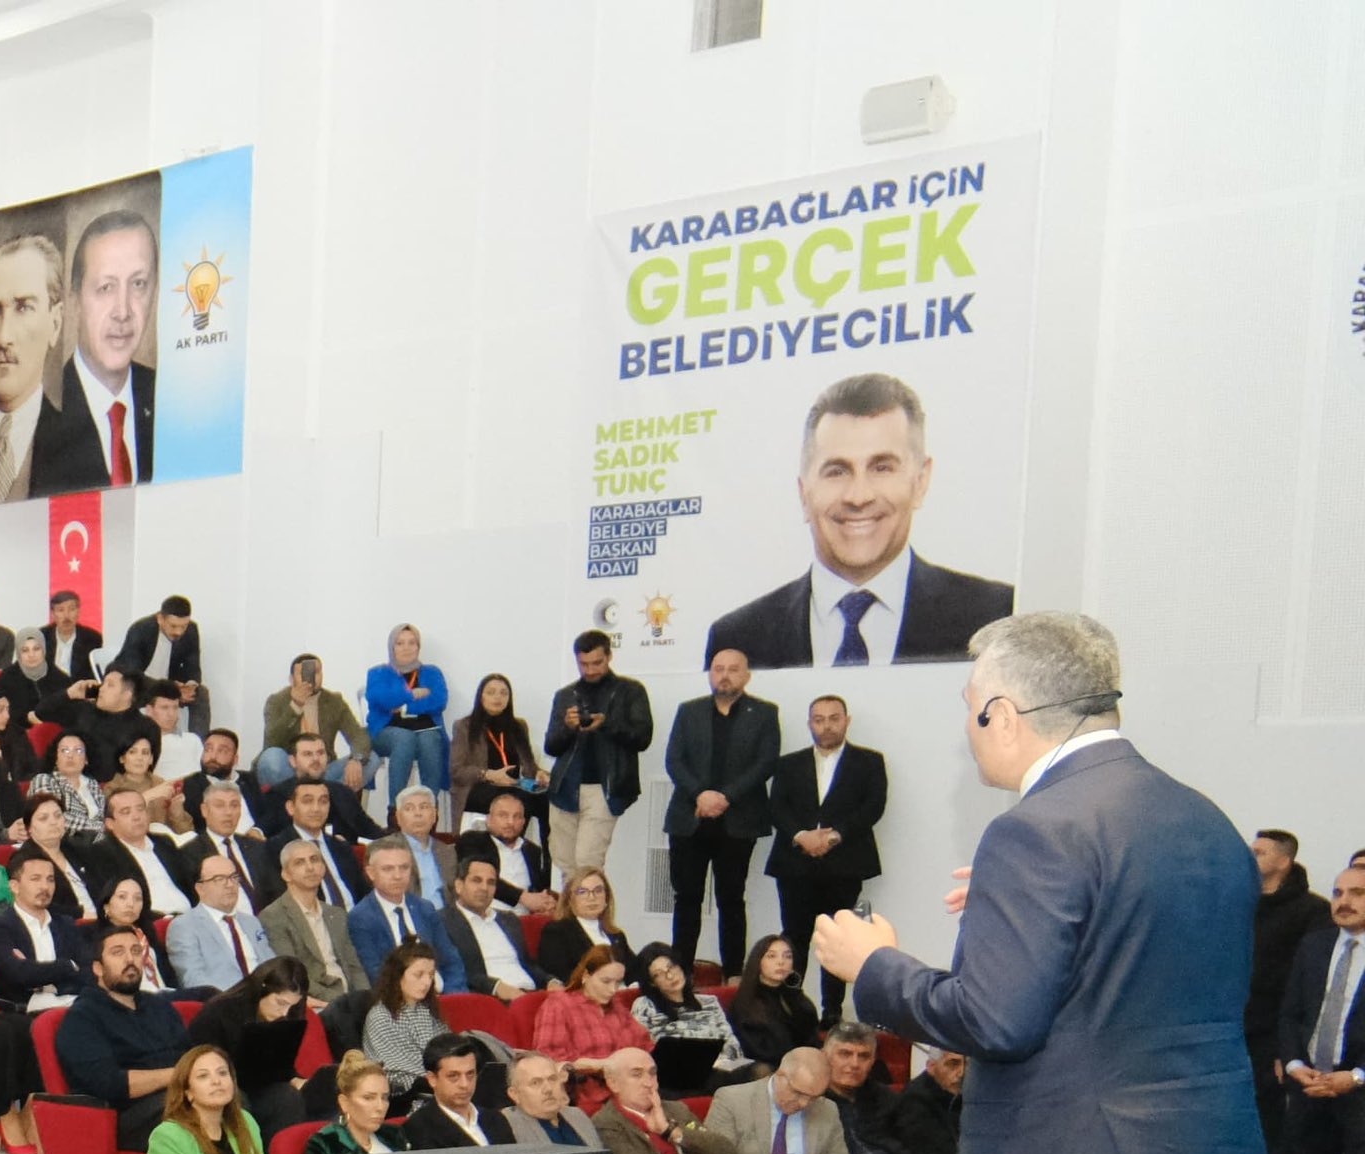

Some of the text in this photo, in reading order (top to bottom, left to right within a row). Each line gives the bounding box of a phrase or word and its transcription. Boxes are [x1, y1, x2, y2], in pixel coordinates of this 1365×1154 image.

[630, 183, 898, 253] KARABAĞLAR
[626, 203, 982, 326] GERÇEK
[176, 337, 191, 351] AK
[595, 409, 719, 445] MEHMET
[593, 440, 681, 471] SADIK
[592, 467, 667, 497] TUNÇ
[588, 559, 636, 577] ADAYI
